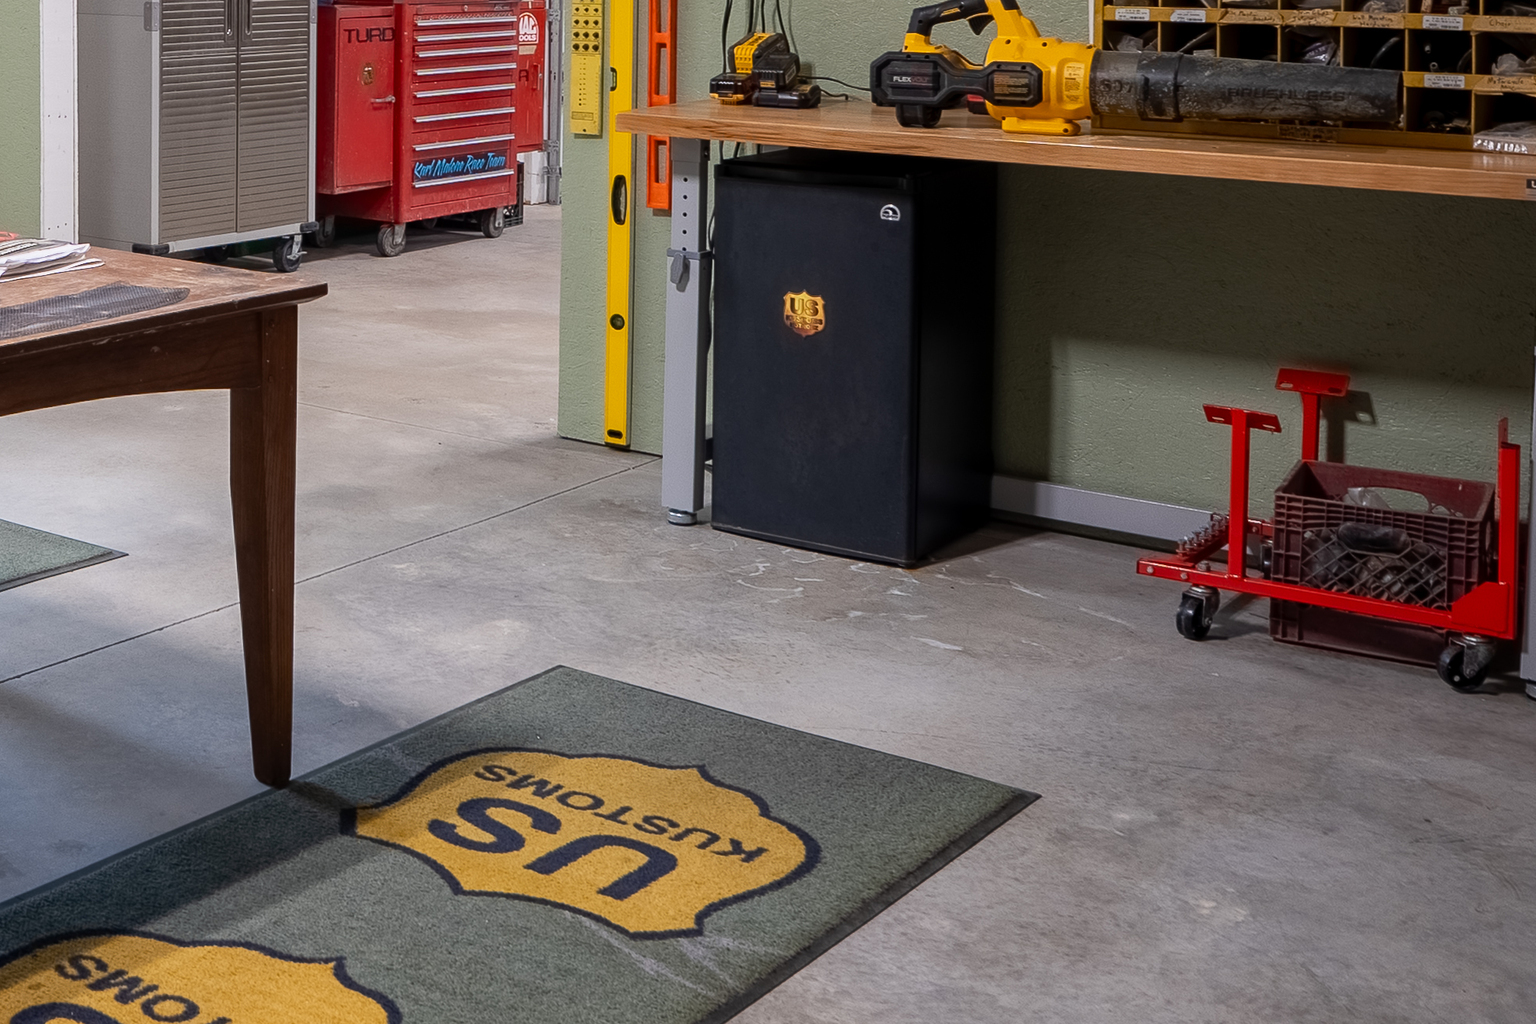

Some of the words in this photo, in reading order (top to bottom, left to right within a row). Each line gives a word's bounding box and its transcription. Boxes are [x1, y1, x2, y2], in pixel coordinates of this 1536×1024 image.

[790, 297, 819, 317] US
[426, 797, 678, 902] US
[474, 763, 770, 865] KUSTOMS
